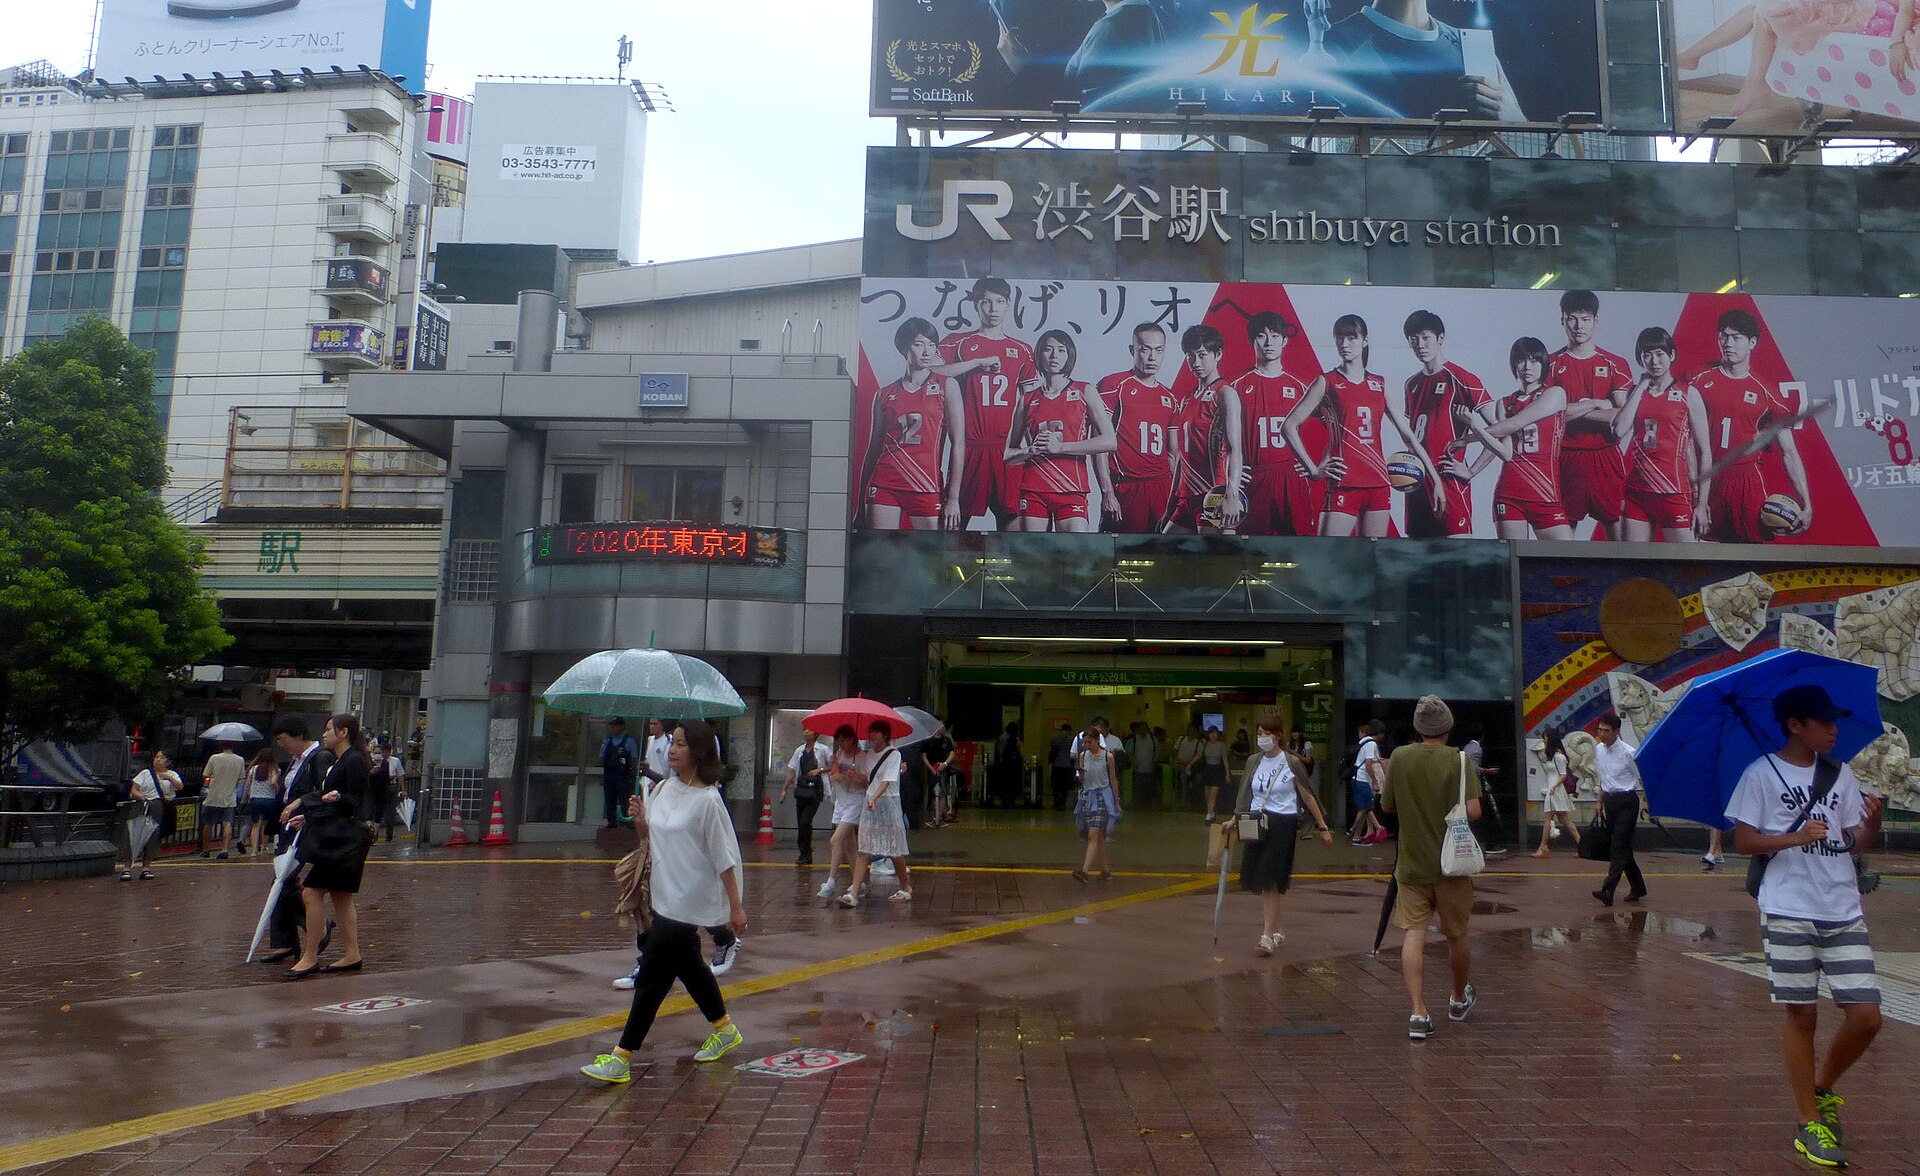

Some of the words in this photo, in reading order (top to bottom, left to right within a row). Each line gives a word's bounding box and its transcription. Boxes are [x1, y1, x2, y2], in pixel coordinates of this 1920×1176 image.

[1195, 2, 1289, 77] 光
[914, 54, 956, 64] セットで
[912, 88, 974, 102] SoftBank
[1168, 87, 1316, 103] HIKARI
[502, 158, 596, 170] 03-3543-7771
[523, 146, 577, 156] 広告募集中
[520, 172, 583, 180] www.hit-ad.co.jp
[896, 179, 1013, 241] JR
[1032, 182, 1232, 243] 渋谷駅
[1250, 209, 1409, 247] shibuya
[1426, 215, 1561, 246] station
[642, 393, 683, 401] KOBAN
[980, 375, 1008, 407] 12
[898, 412, 922, 445] 12
[1257, 417, 1286, 449] 15
[1357, 407, 1372, 437] 3
[1721, 417, 1731, 448] 1
[1138, 421, 1163, 455] 13
[257, 531, 302, 574] 駅
